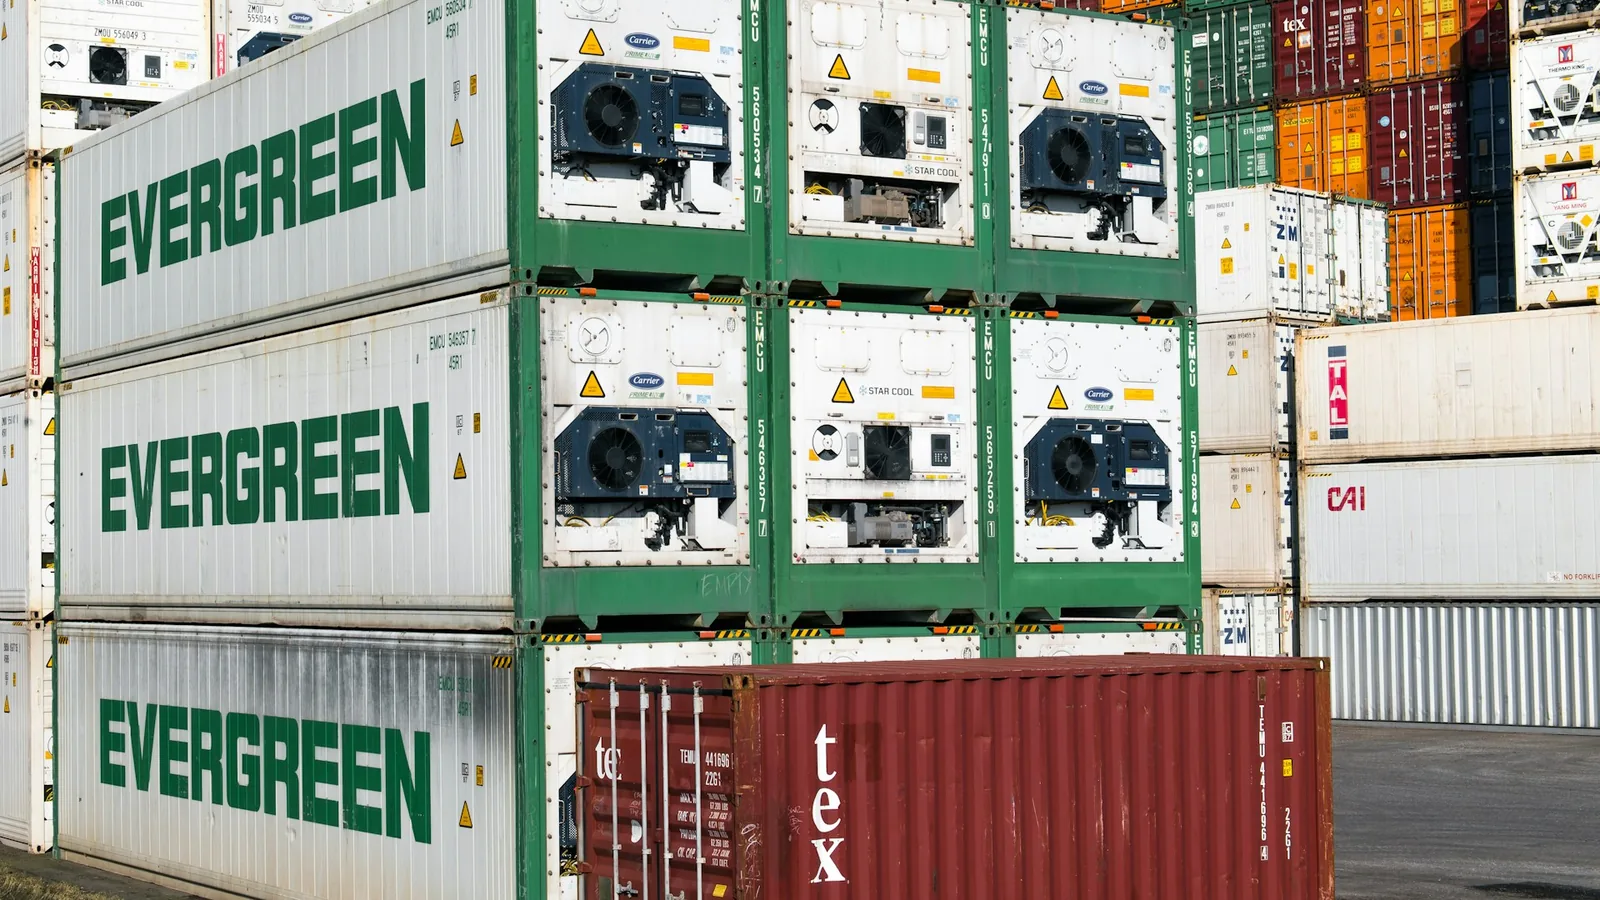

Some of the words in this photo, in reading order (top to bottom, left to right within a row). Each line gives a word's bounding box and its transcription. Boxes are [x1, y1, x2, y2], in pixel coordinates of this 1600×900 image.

[247, 14, 271, 24] 555034
[274, 16, 279, 24] 5
[248, 4, 264, 14] ZMOU
[290, 14, 311, 22] Carrier
[427, 5, 443, 25] EMCU
[94, 28, 111, 38] ZMOU
[114, 29, 138, 40] 556049
[142, 32, 147, 41] 3
[446, 22, 459, 39] 45R1
[628, 35, 656, 46] Carrier
[979, 9, 988, 66] EMCU
[1184, 50, 1192, 105] EMCU
[1082, 83, 1105, 93] Carrier
[753, 87, 761, 179] 560534
[981, 109, 989, 197] 547911
[1185, 112, 1193, 195] 553158
[914, 166, 935, 175] STAR
[937, 168, 959, 177] COOL
[102, 78, 426, 286] EVERGREEN
[754, 186, 762, 203] 7
[982, 203, 990, 219] 0
[1187, 201, 1195, 217] 4
[430, 334, 446, 351] EMCU
[448, 330, 469, 347] 546357
[755, 311, 764, 372] EMCU
[984, 321, 993, 380] EMCU
[449, 355, 463, 370] 45R1
[1188, 331, 1196, 387] EMCU
[632, 376, 660, 386] Carrier
[868, 387, 889, 395] STAR
[891, 388, 914, 396] COOL
[1087, 390, 1110, 399] Carrier
[1329, 361, 1347, 423] TAL
[102, 402, 430, 532] EVERGREEN
[757, 420, 766, 513] 546357
[986, 426, 994, 514] 565259
[1190, 431, 1198, 515] 571984
[1327, 486, 1365, 512] CAI
[758, 519, 767, 537] 7
[987, 521, 995, 538] 1
[1191, 521, 1198, 537] 3
[1258, 705, 1266, 758] TEMU
[705, 752, 730, 768] 441696
[100, 698, 432, 845] EVERGREEN
[705, 771, 721, 787] 22G1
[810, 723, 846, 883] tex
[1259, 762, 1267, 841] 441696
